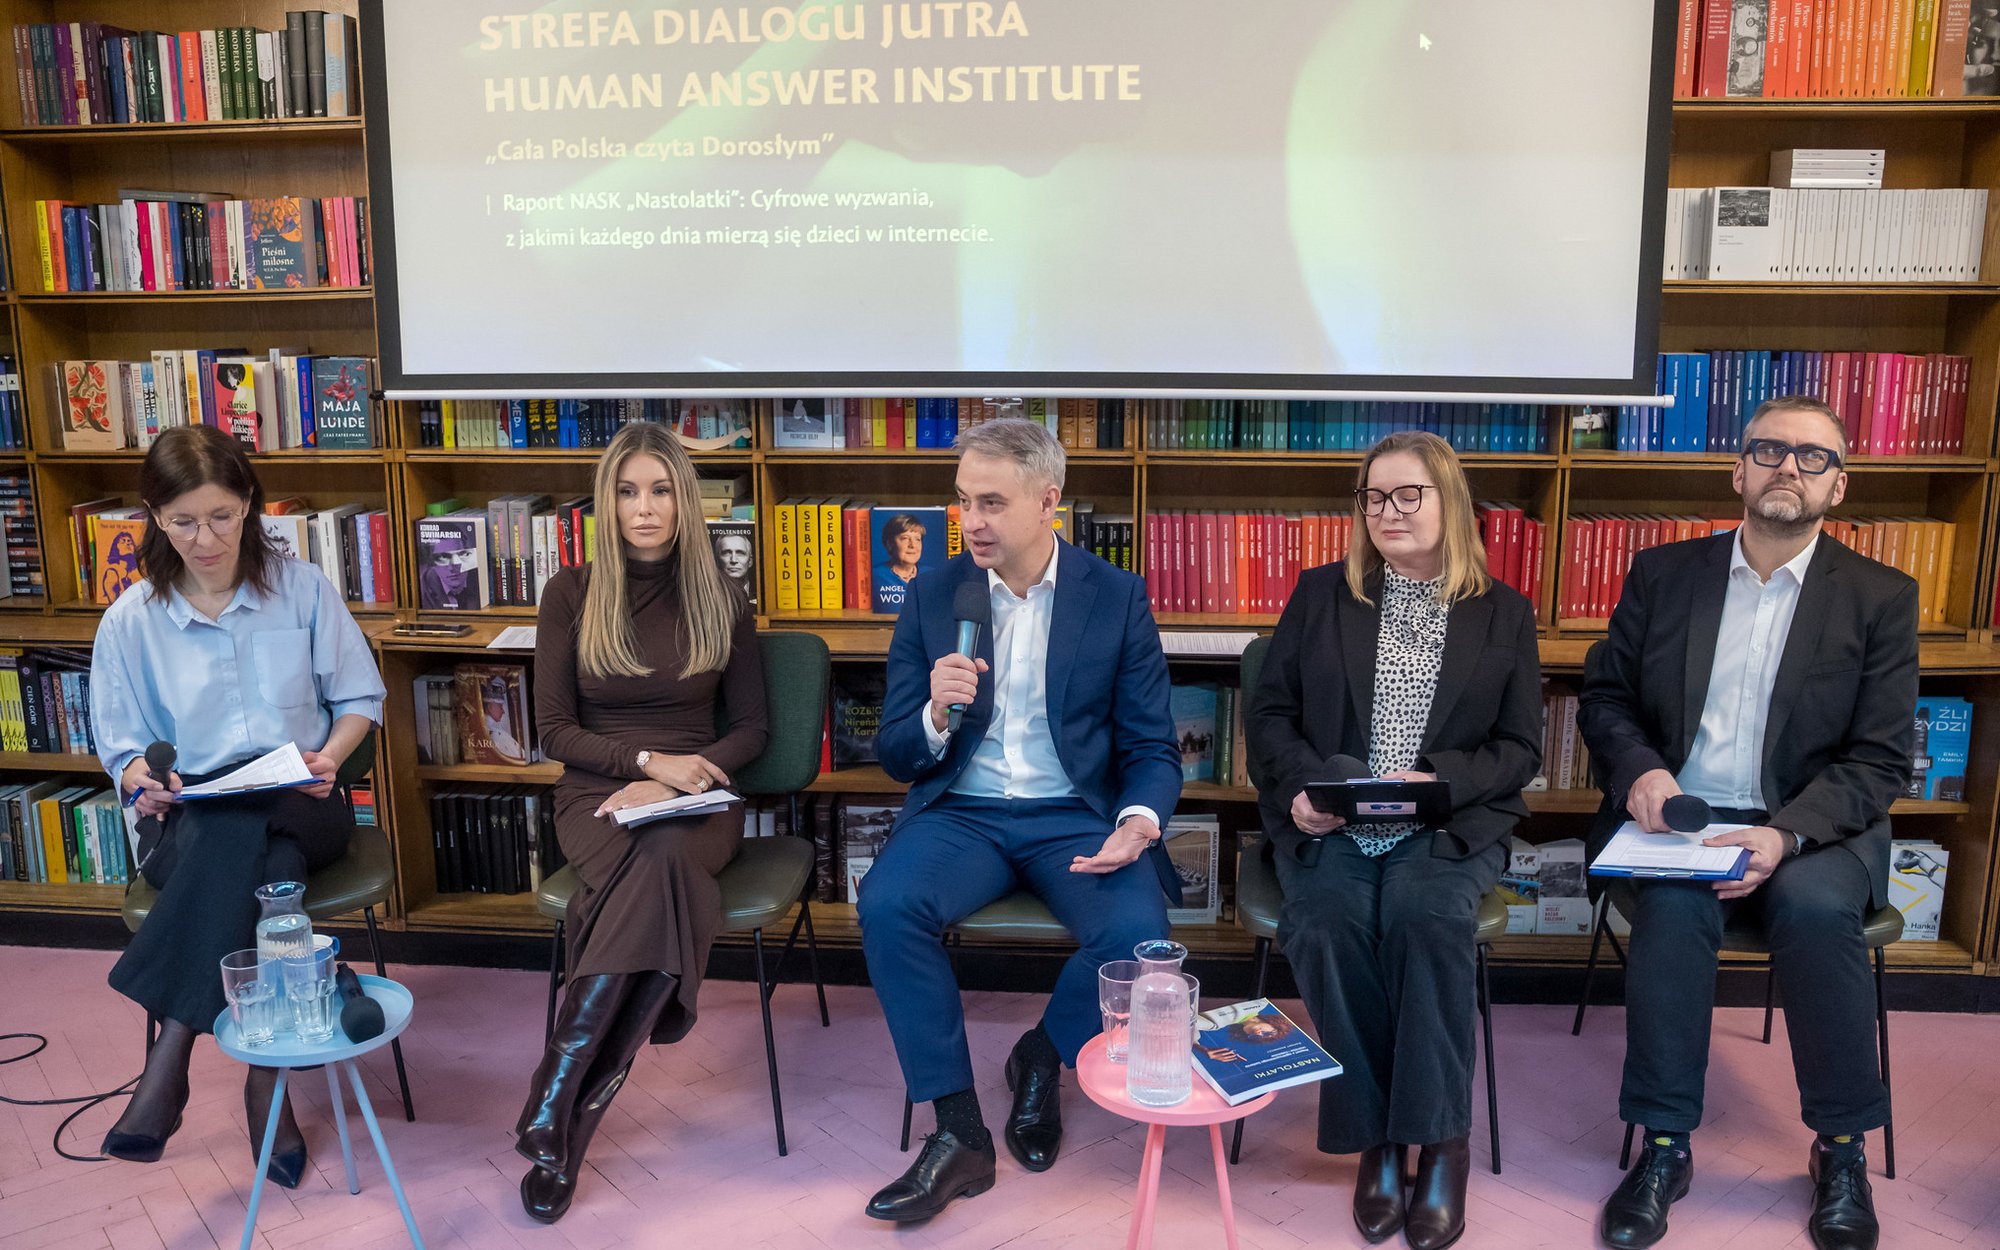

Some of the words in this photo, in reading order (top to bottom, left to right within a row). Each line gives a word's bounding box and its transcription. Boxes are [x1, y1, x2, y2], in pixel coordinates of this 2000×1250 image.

[1684, 1, 1693, 21] Krew
[480, 9, 641, 51] STREFA
[654, 4, 864, 47] DIALOGU
[881, 1, 1029, 49] JUTRA
[1682, 28, 1692, 50] burza
[1778, 15, 1787, 44] Wrzask
[217, 30, 228, 74] MODELKA
[231, 30, 241, 73] MODELKA
[244, 30, 254, 73] MODELKA
[485, 75, 663, 112] HUMAN
[677, 68, 880, 108] ANSWER
[893, 64, 1141, 104] INSTITUTE
[485, 140, 545, 164] „Cała
[552, 137, 627, 160] Polska
[634, 139, 695, 162] czyta
[702, 132, 834, 160] Dorosłym”
[503, 192, 564, 215] Raport
[570, 191, 620, 211] NASK
[626, 189, 746, 214] „Nastolatki”:
[751, 188, 828, 211] Cyfrowe
[834, 187, 935, 210] wyzwania,
[506, 235, 514, 248] z
[519, 227, 574, 250] jakimi
[579, 225, 654, 248] każdego
[659, 226, 700, 245] dnia
[706, 225, 769, 248] mierzą
[774, 225, 802, 247] się
[807, 224, 861, 243] dzieci
[866, 229, 883, 242] w
[888, 223, 994, 242] internecie.
[262, 246, 286, 257] Pieśni
[262, 256, 295, 266] miłosne
[323, 400, 361, 412] MAJA
[511, 399, 522, 428] MEDA
[321, 417, 366, 429] LUNDE
[419, 524, 440, 532] KONRAD
[420, 531, 462, 539] SWINARSKI
[950, 520, 959, 552] ASTRID
[360, 523, 368, 567] PROULX
[781, 511, 790, 580] SEBALD
[803, 510, 813, 580] SEBALD
[826, 510, 836, 580] SEBALD
[26, 685, 36, 703] CIEŃ
[53, 679, 65, 724] RODOREDA
[29, 705, 38, 726] GÓRY
[844, 717, 880, 727] Nireńsk
[845, 706, 882, 715] ROZBIC
[1911, 922, 1936, 930] Hanka
[1254, 1056, 1321, 1079] NASTOLATKI
